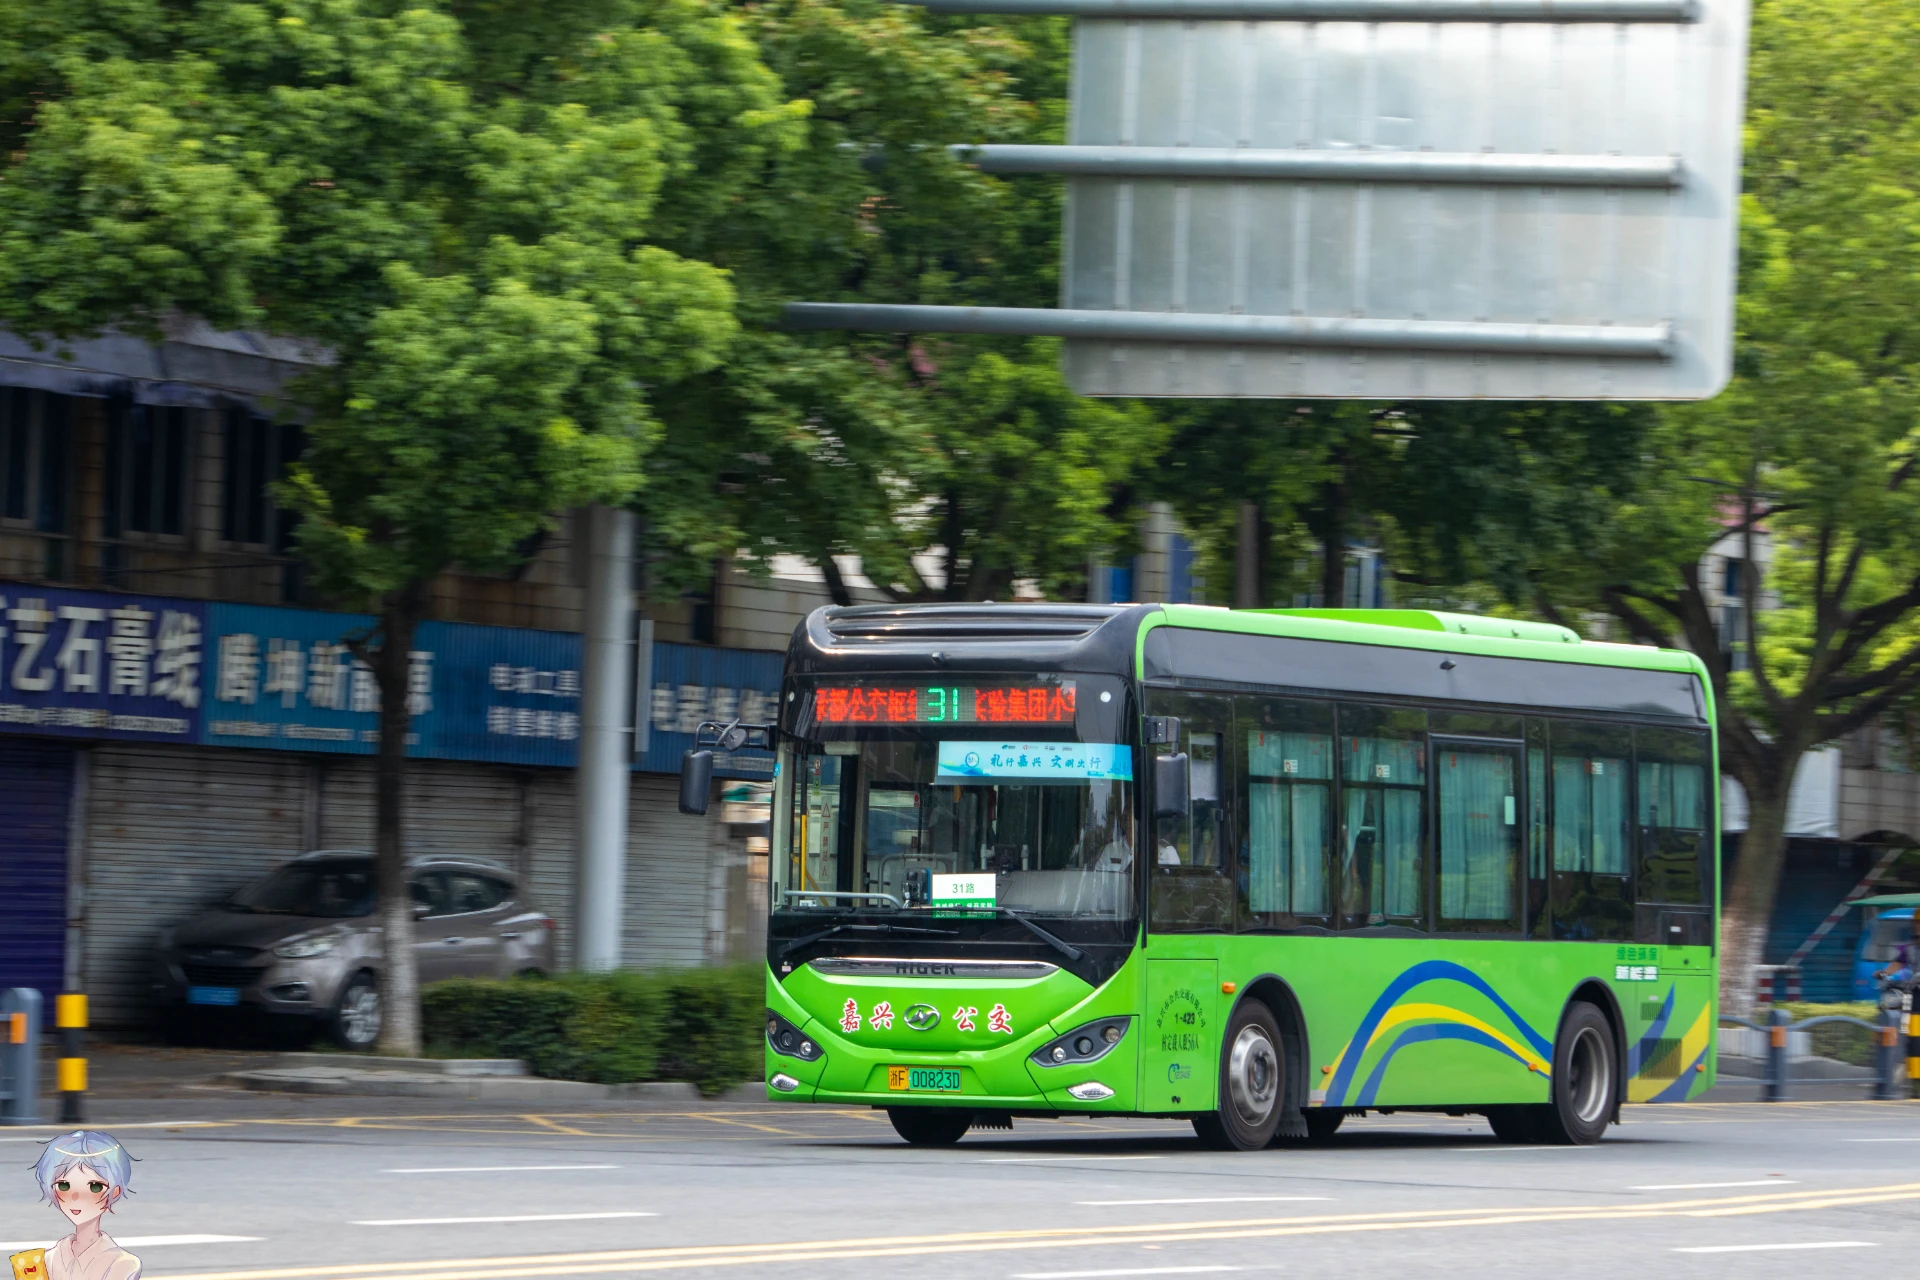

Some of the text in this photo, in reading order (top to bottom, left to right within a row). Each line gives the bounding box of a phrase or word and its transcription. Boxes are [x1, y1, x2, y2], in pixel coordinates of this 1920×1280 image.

[0, 595, 202, 708] 艺石膏线
[927, 687, 959, 721] 31
[952, 883, 975, 894] 31路
[895, 962, 956, 975] HIGER
[839, 998, 1013, 1035] 嘉兴 公交
[1174, 1012, 1196, 1025] 1-423
[890, 1069, 960, 1089] 浙F 00823D
